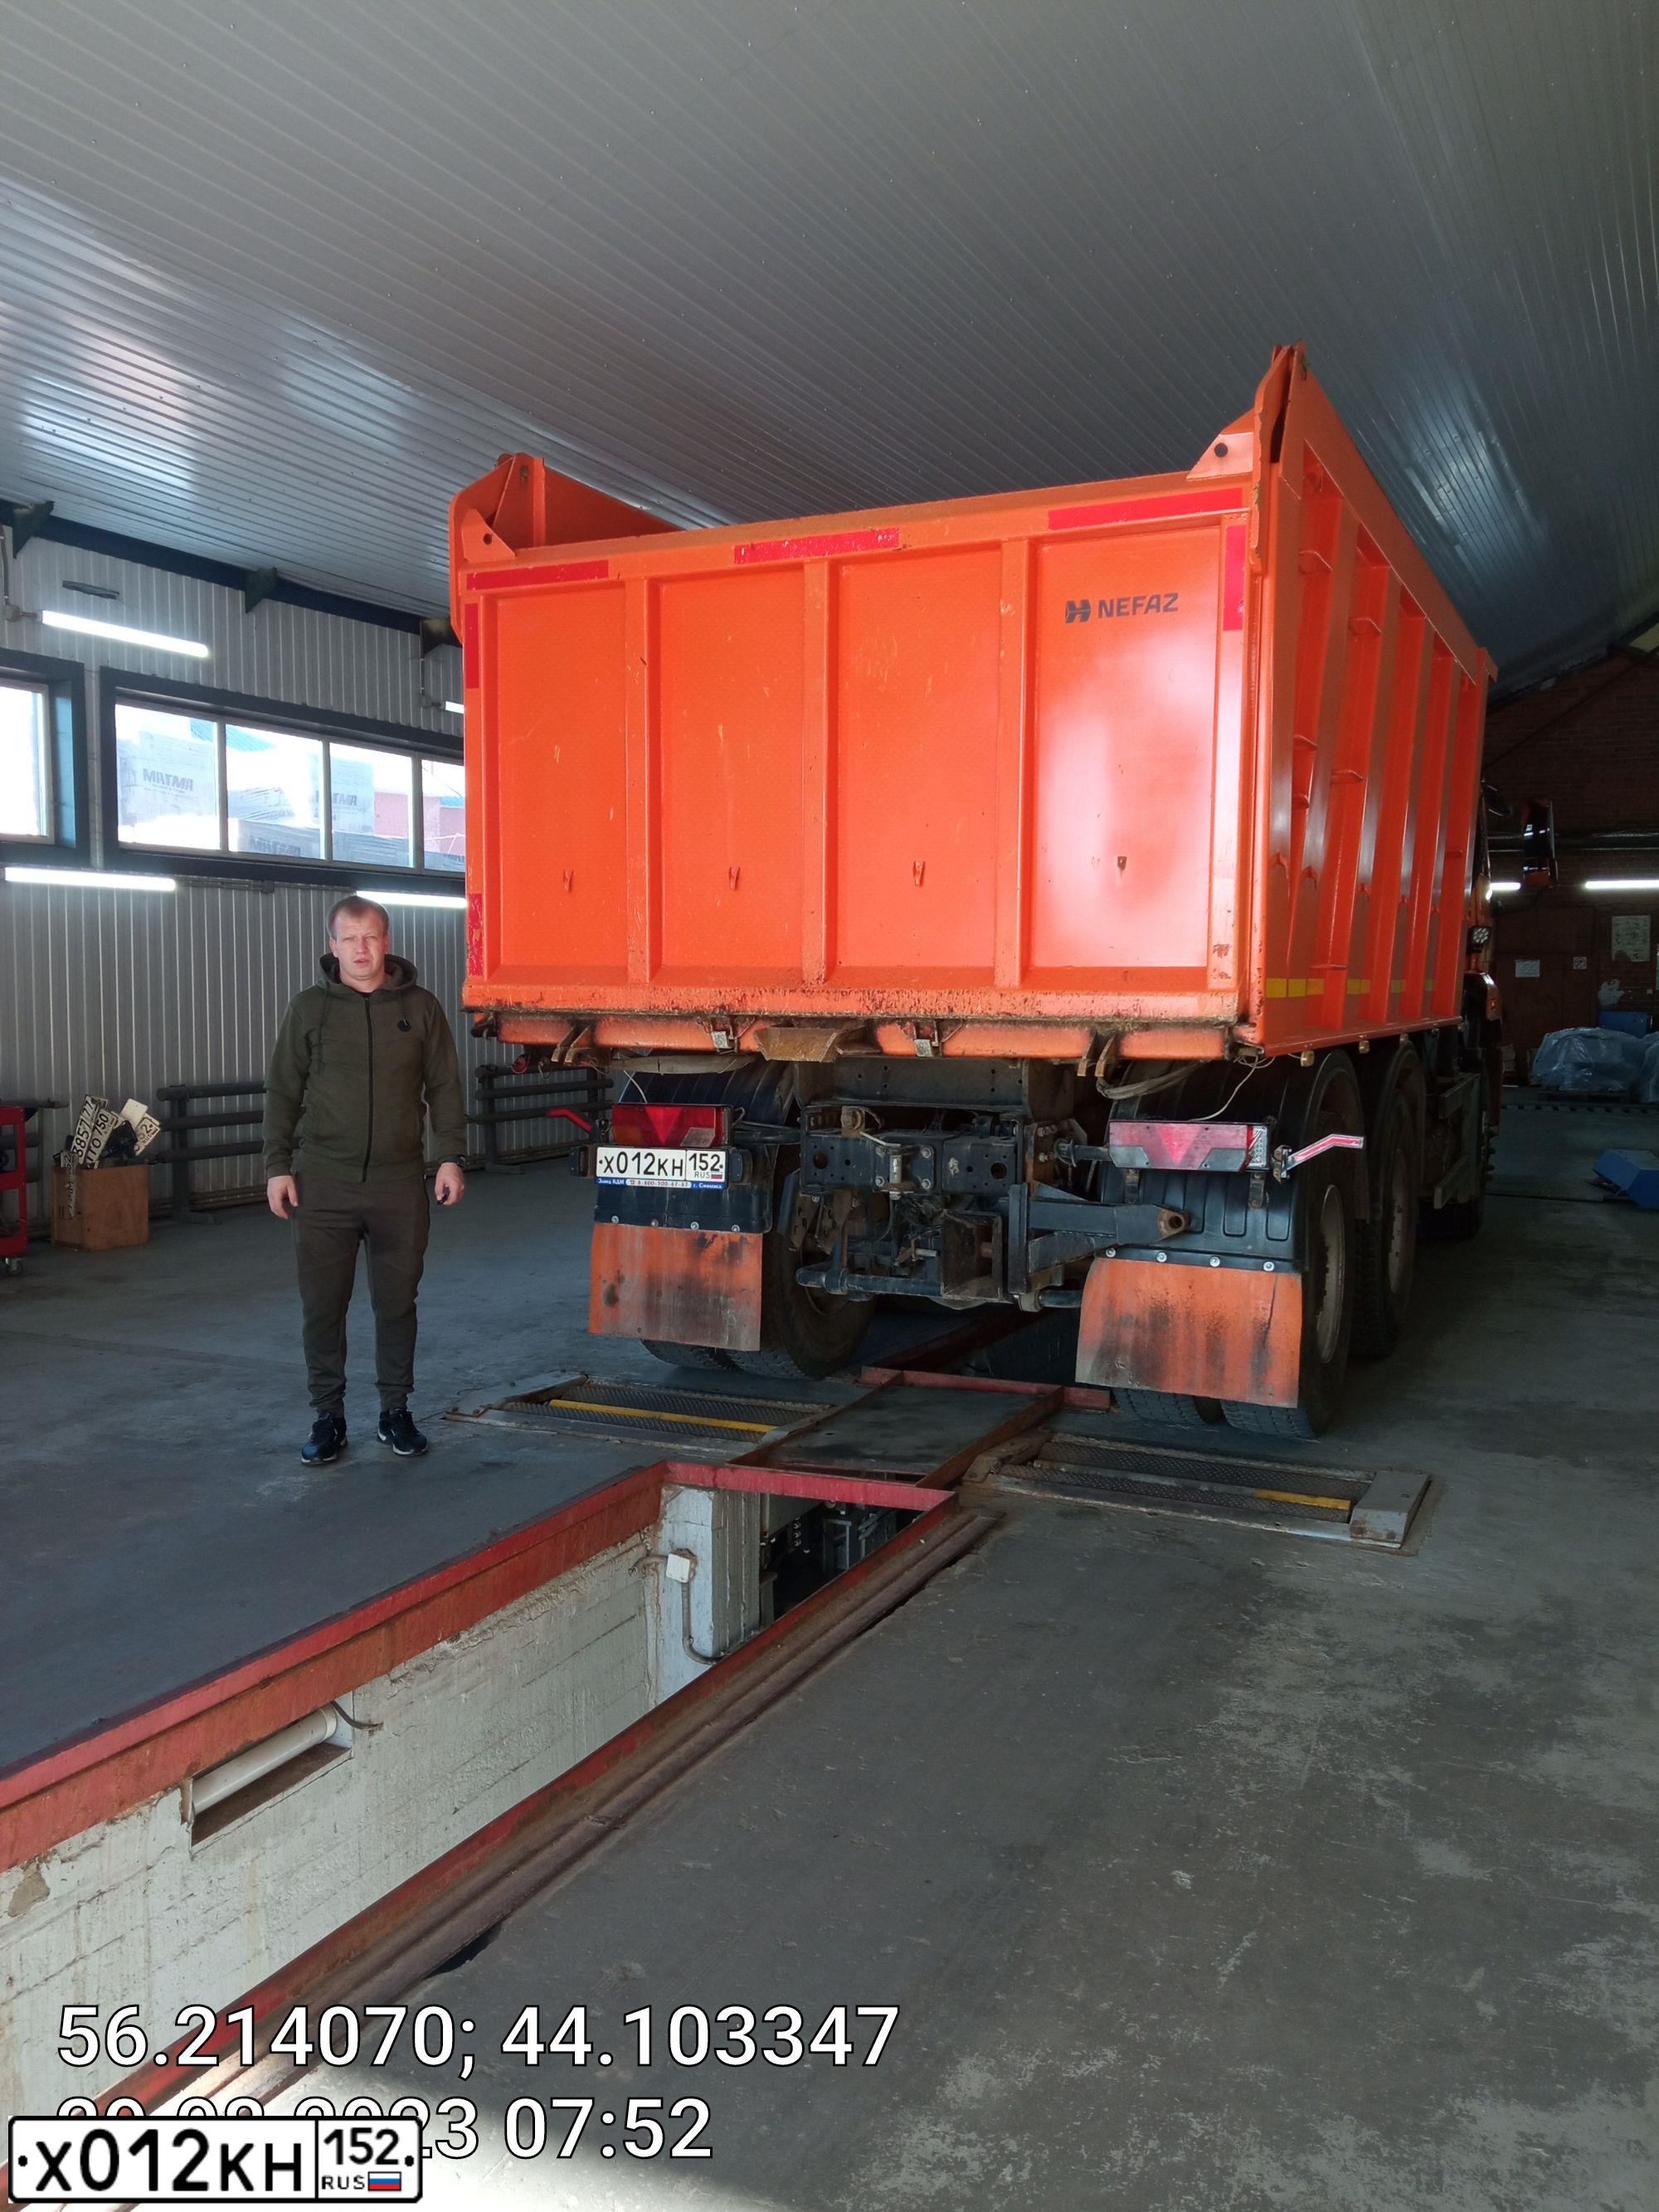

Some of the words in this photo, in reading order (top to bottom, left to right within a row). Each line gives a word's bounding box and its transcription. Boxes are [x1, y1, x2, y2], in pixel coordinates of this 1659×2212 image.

[1098, 592, 1179, 618] NEFAZ
[93, 1113, 109, 1137] 750
[72, 1118, 90, 1158] 3857
[688, 1153, 720, 1172] 152
[694, 1171, 710, 1179] RUS
